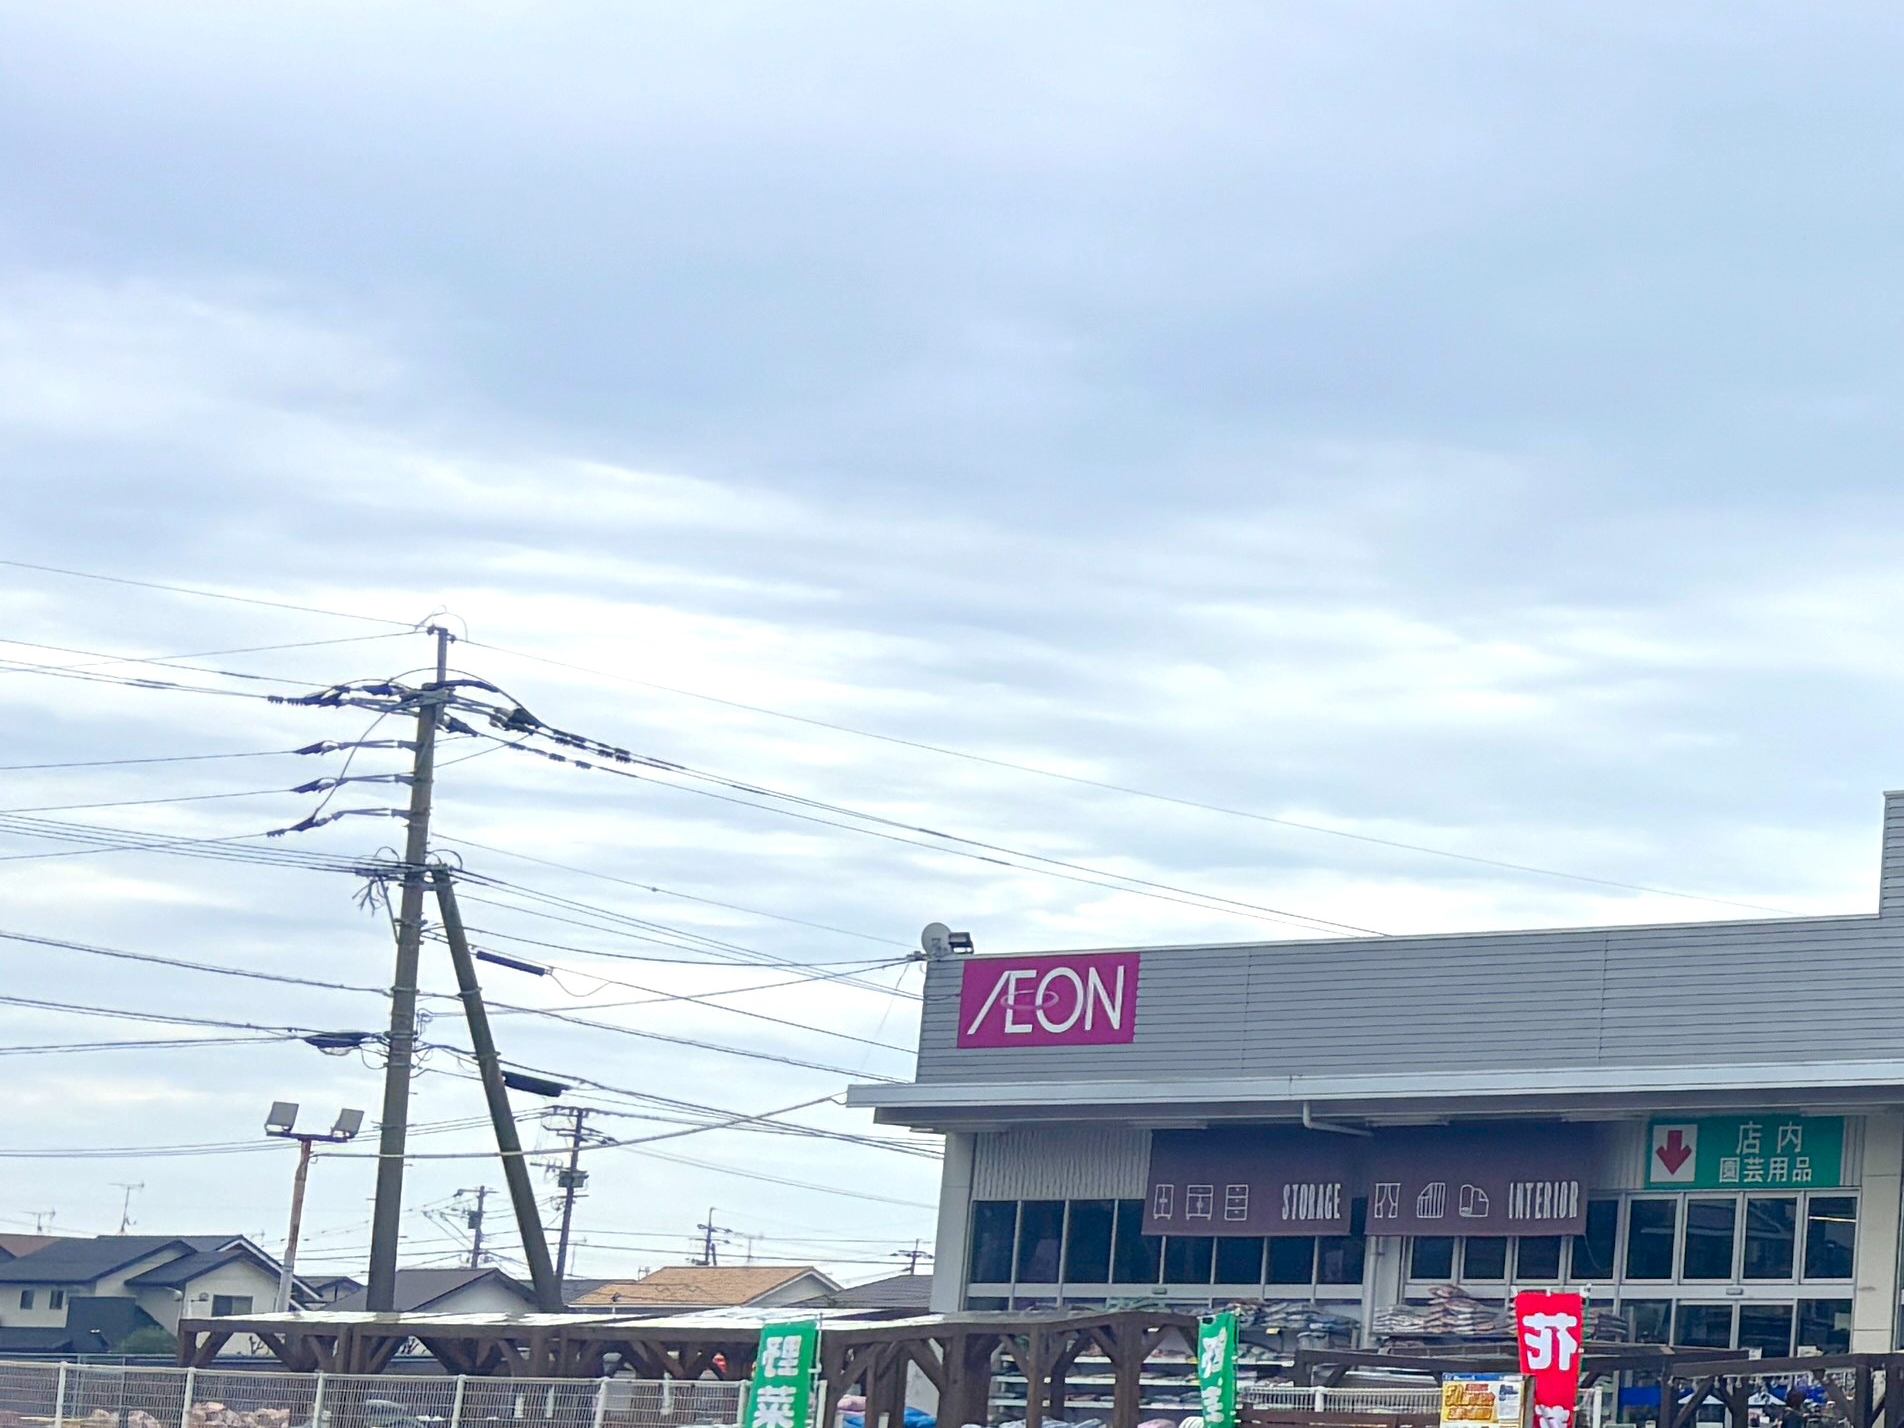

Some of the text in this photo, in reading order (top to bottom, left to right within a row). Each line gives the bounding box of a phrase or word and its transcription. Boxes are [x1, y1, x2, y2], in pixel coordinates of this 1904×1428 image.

[1735, 1121, 1804, 1154] 店内
[1282, 1182, 1341, 1220] STORAGE
[1508, 1180, 1579, 1220] INTERIOR
